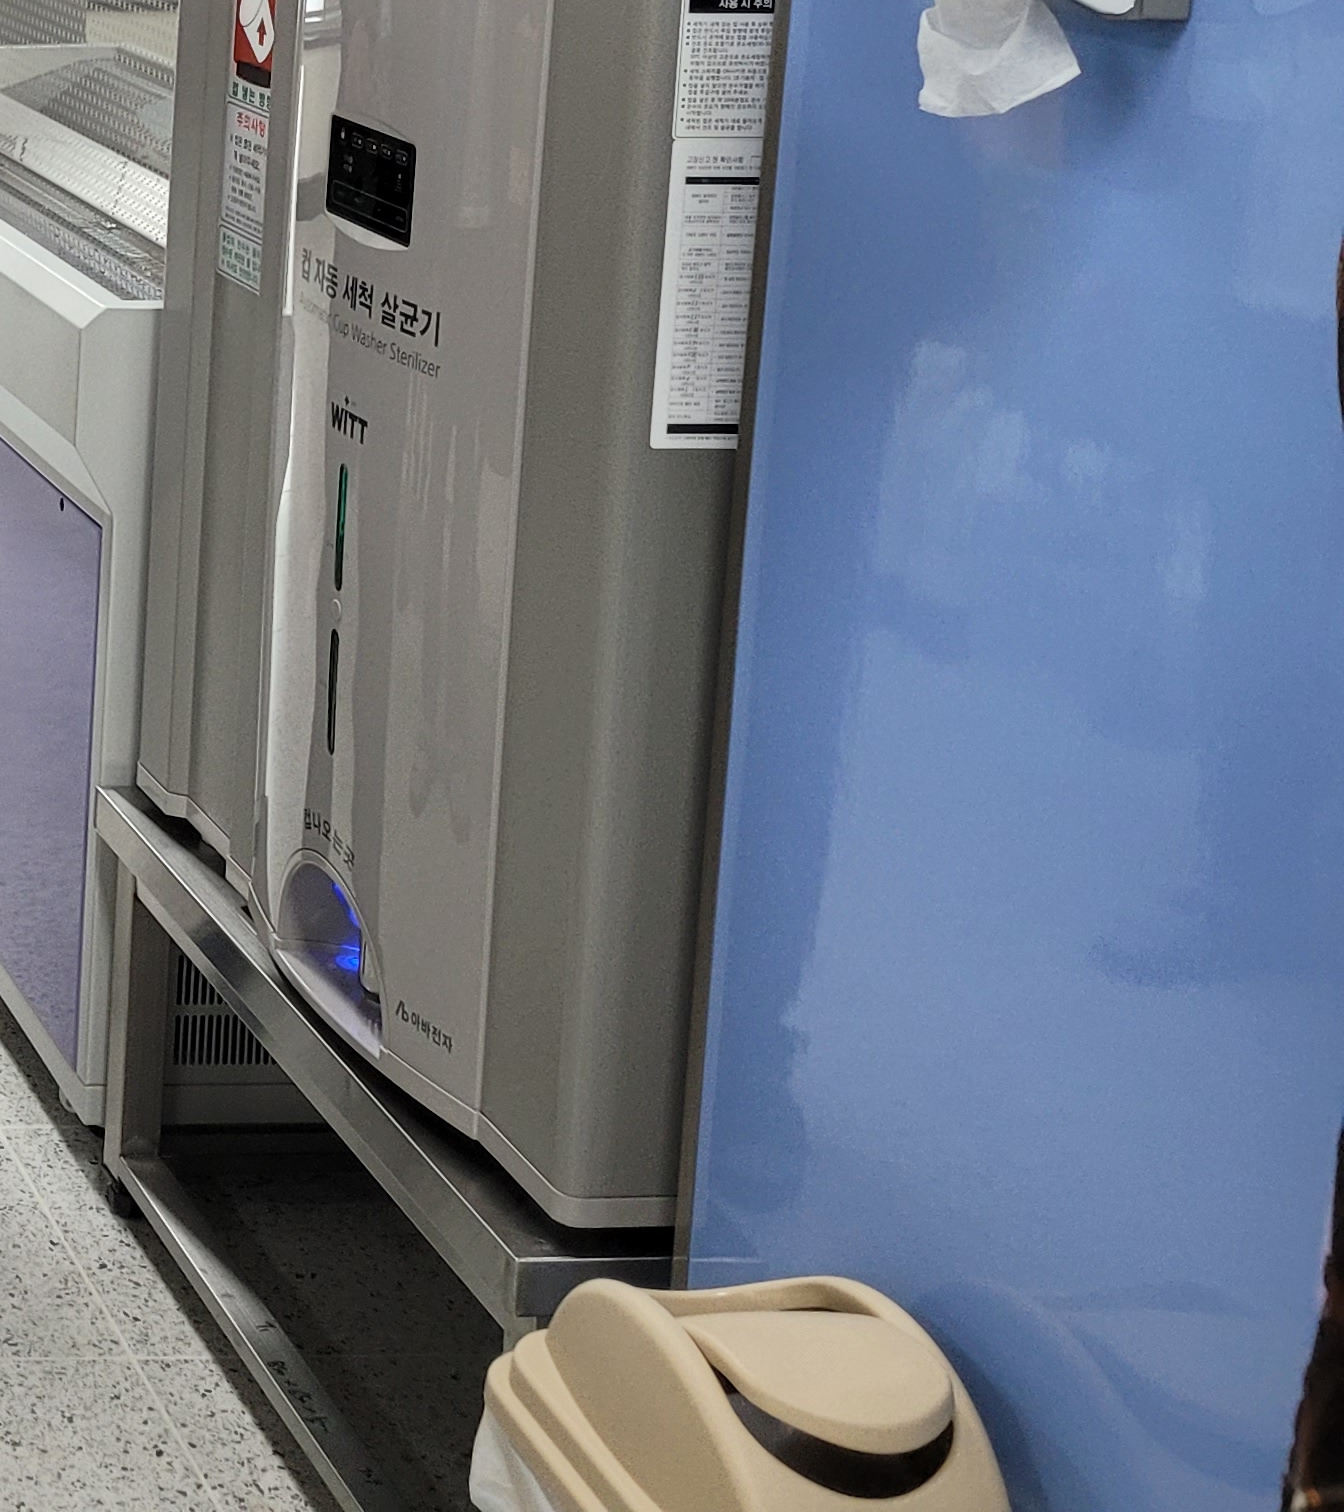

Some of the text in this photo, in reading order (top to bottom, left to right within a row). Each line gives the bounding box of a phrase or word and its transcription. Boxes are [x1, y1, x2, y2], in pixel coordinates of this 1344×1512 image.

[301, 248, 312, 283] 컵
[314, 257, 339, 299] 자동
[342, 274, 375, 320] 세척
[380, 292, 441, 348] 살균기
[333, 314, 441, 379] Cup Washer Sterilizer
[410, 1011, 453, 1055] 아바전자
